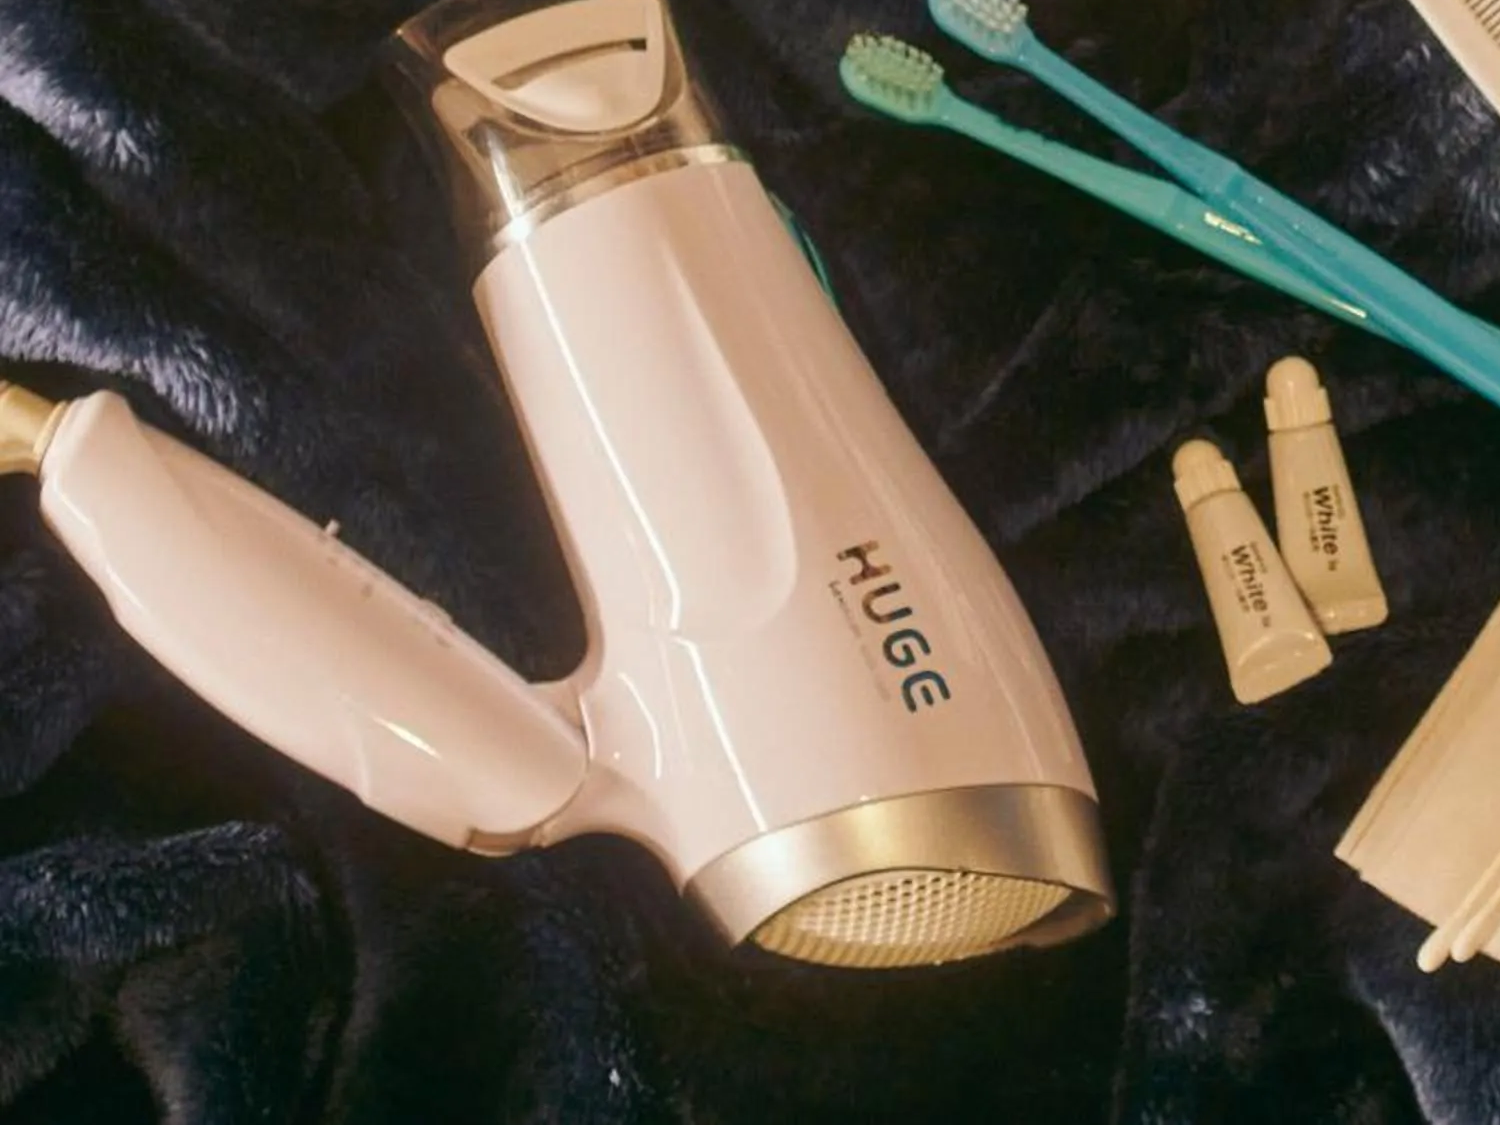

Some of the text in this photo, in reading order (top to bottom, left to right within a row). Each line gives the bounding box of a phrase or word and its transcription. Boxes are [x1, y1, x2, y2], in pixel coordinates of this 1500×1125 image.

[1312, 486, 1340, 556] White
[1231, 544, 1268, 614] White
[836, 540, 952, 713] HUGE
